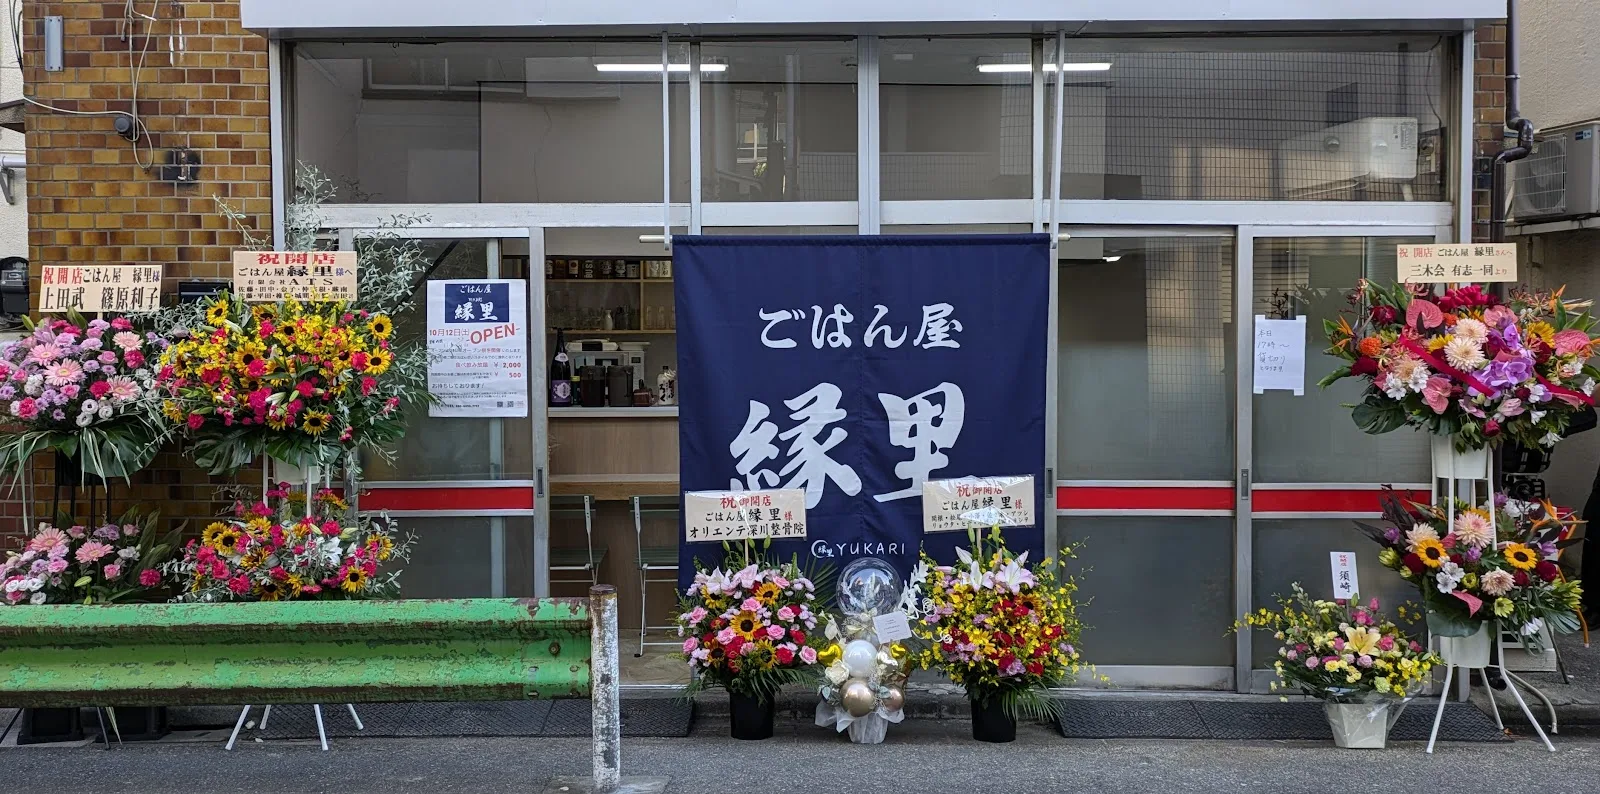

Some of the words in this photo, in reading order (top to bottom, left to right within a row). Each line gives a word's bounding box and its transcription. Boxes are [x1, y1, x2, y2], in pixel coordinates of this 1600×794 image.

[257, 253, 336, 264] 祝開店
[1398, 248, 1408, 258] 祝
[1414, 248, 1433, 258] 開店
[1438, 248, 1469, 257] ごはん屋
[1410, 264, 1445, 277] 三木会
[1452, 264, 1508, 276] 有志一同より
[460, 284, 492, 294] ごはん屋
[40, 286, 85, 310] 上田武
[100, 286, 159, 310] 篠原利子
[454, 302, 498, 321] 縁里
[758, 302, 964, 350] ごはん屋
[1258, 329, 1272, 338] 本日
[729, 382, 966, 510] 縁里
[720, 495, 772, 509] 祝御開店
[690, 522, 804, 538] オリエンテ深川整骨院
[836, 542, 905, 556] YUKARI
